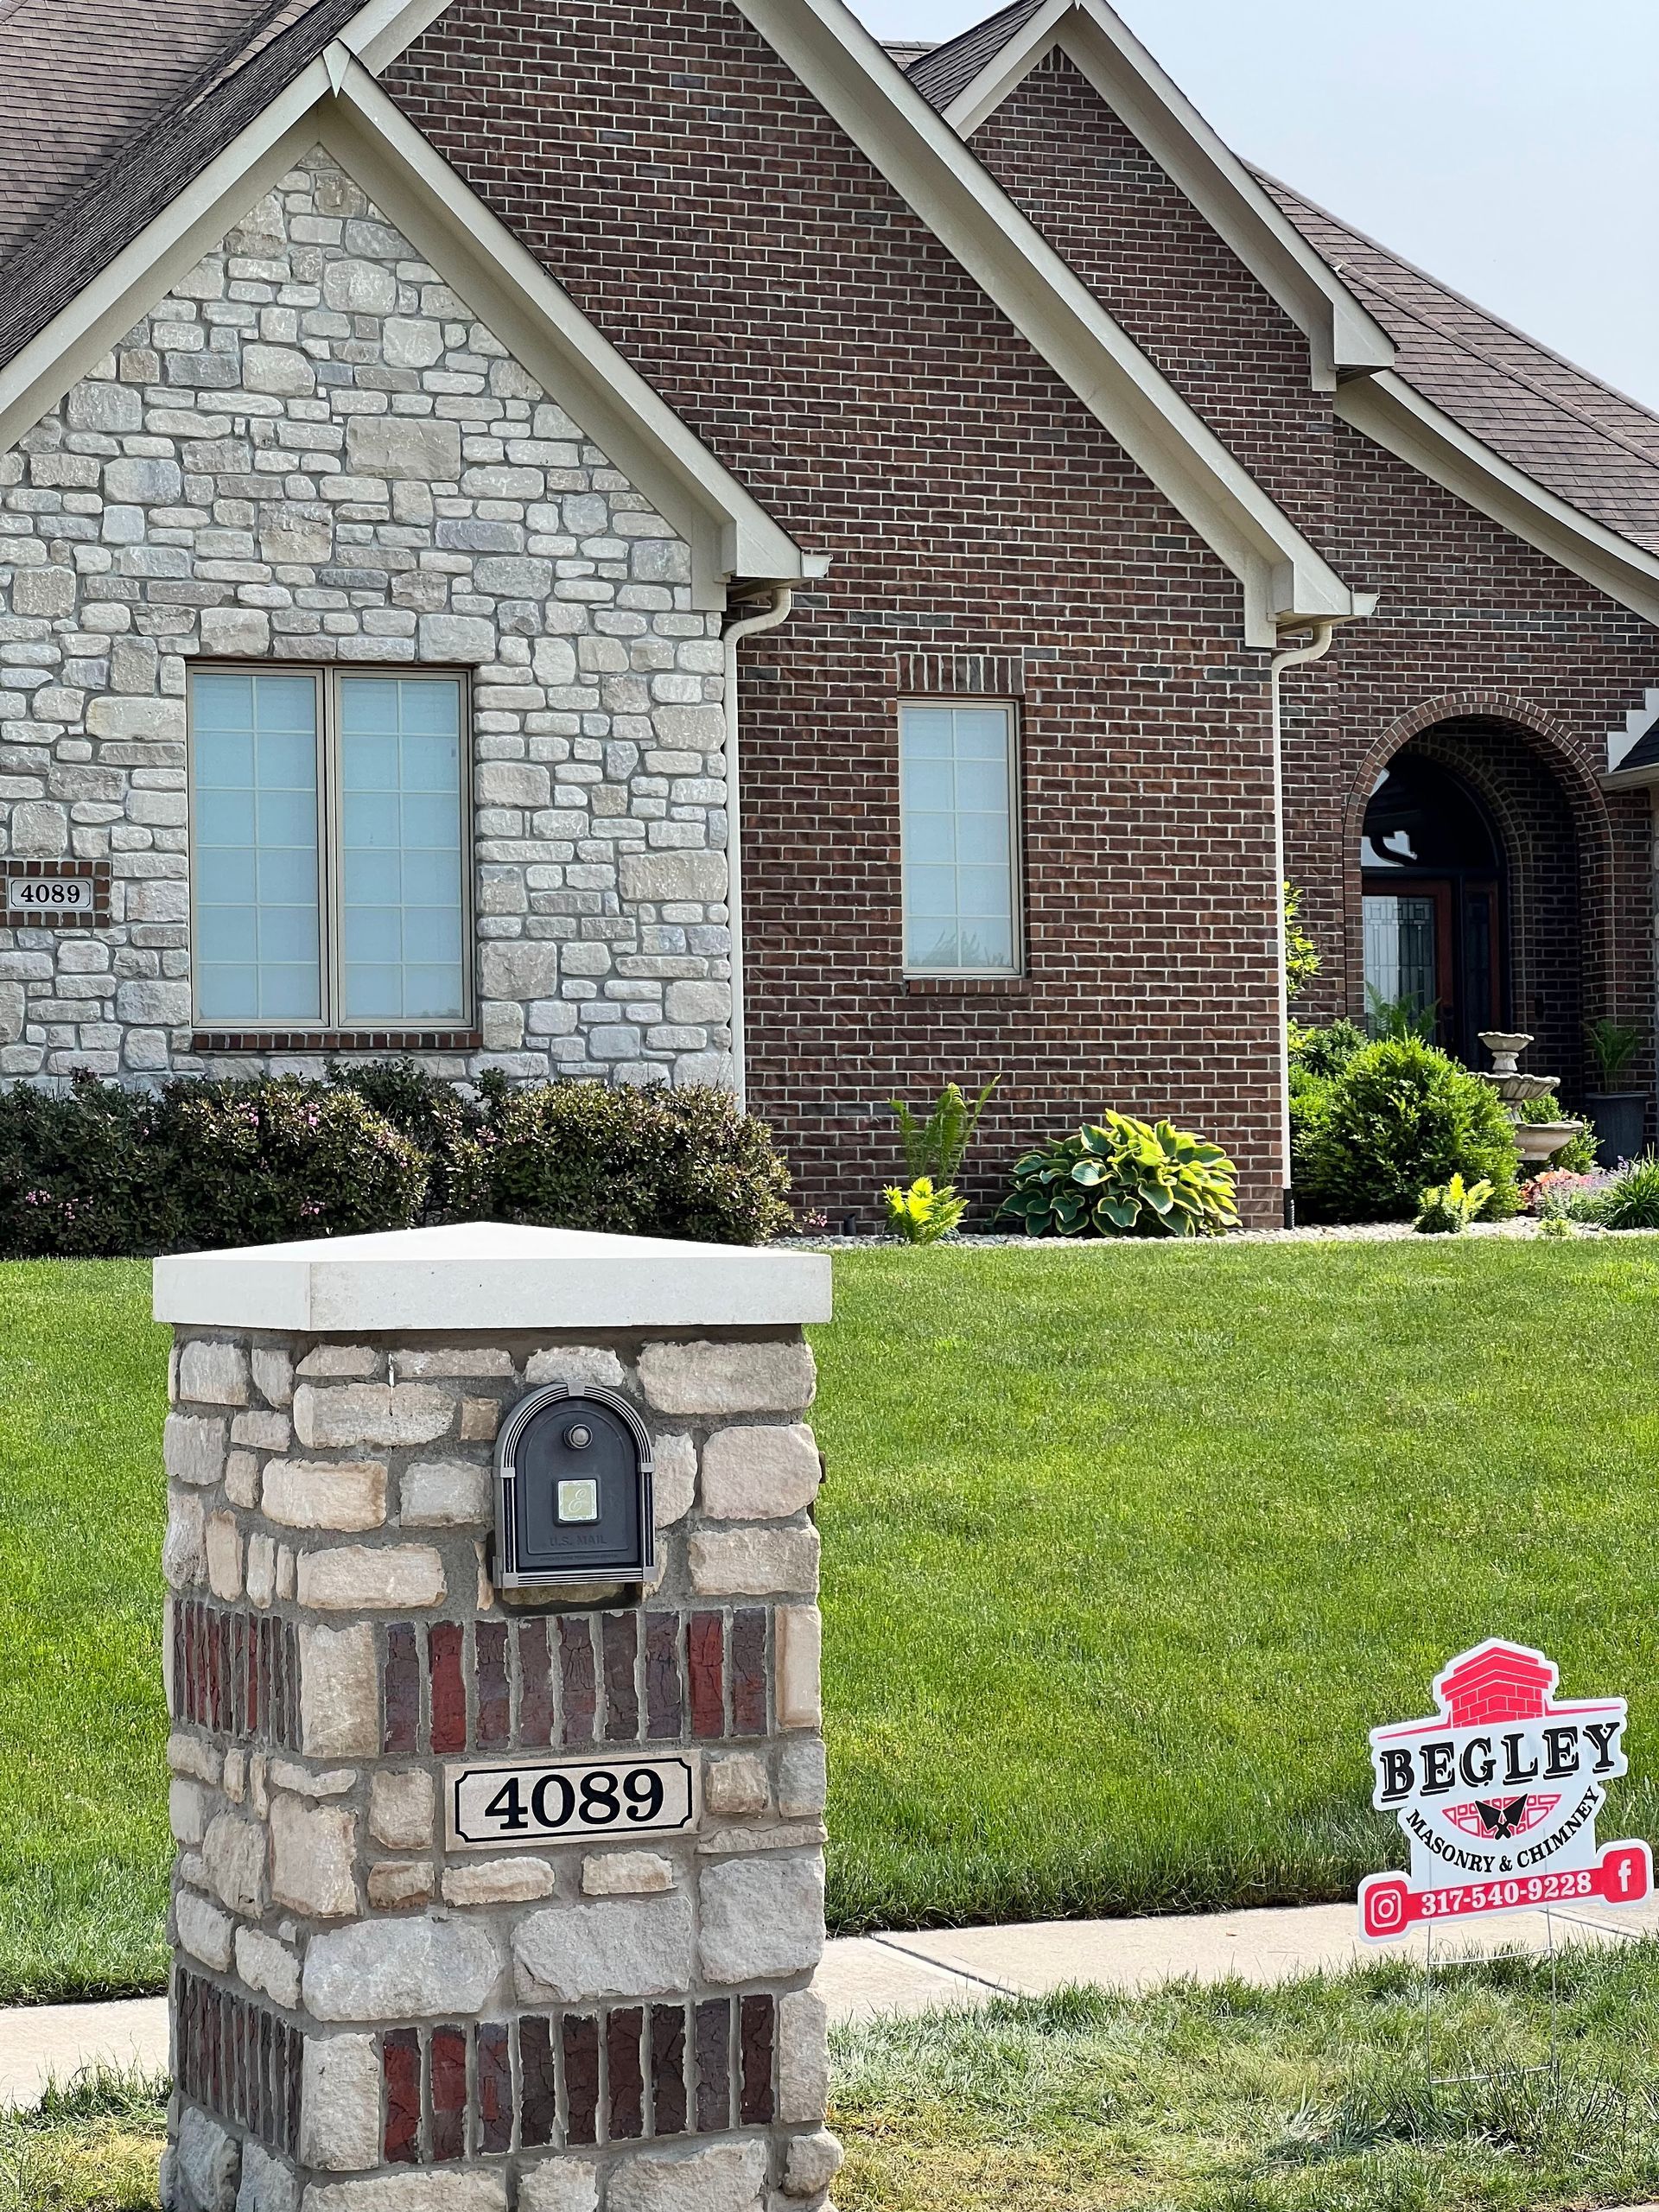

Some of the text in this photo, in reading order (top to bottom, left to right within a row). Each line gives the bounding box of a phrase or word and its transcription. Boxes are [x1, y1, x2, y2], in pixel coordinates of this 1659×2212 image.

[20, 884, 80, 903] 4089
[577, 1535, 607, 1545] MAIL
[1379, 1721, 1620, 1802] BEGLEY
[485, 1768, 664, 1830] 4089
[1406, 1785, 1600, 1873] MASONRY & CHIMNEY
[1421, 1871, 1592, 1916] 317-540-9228
